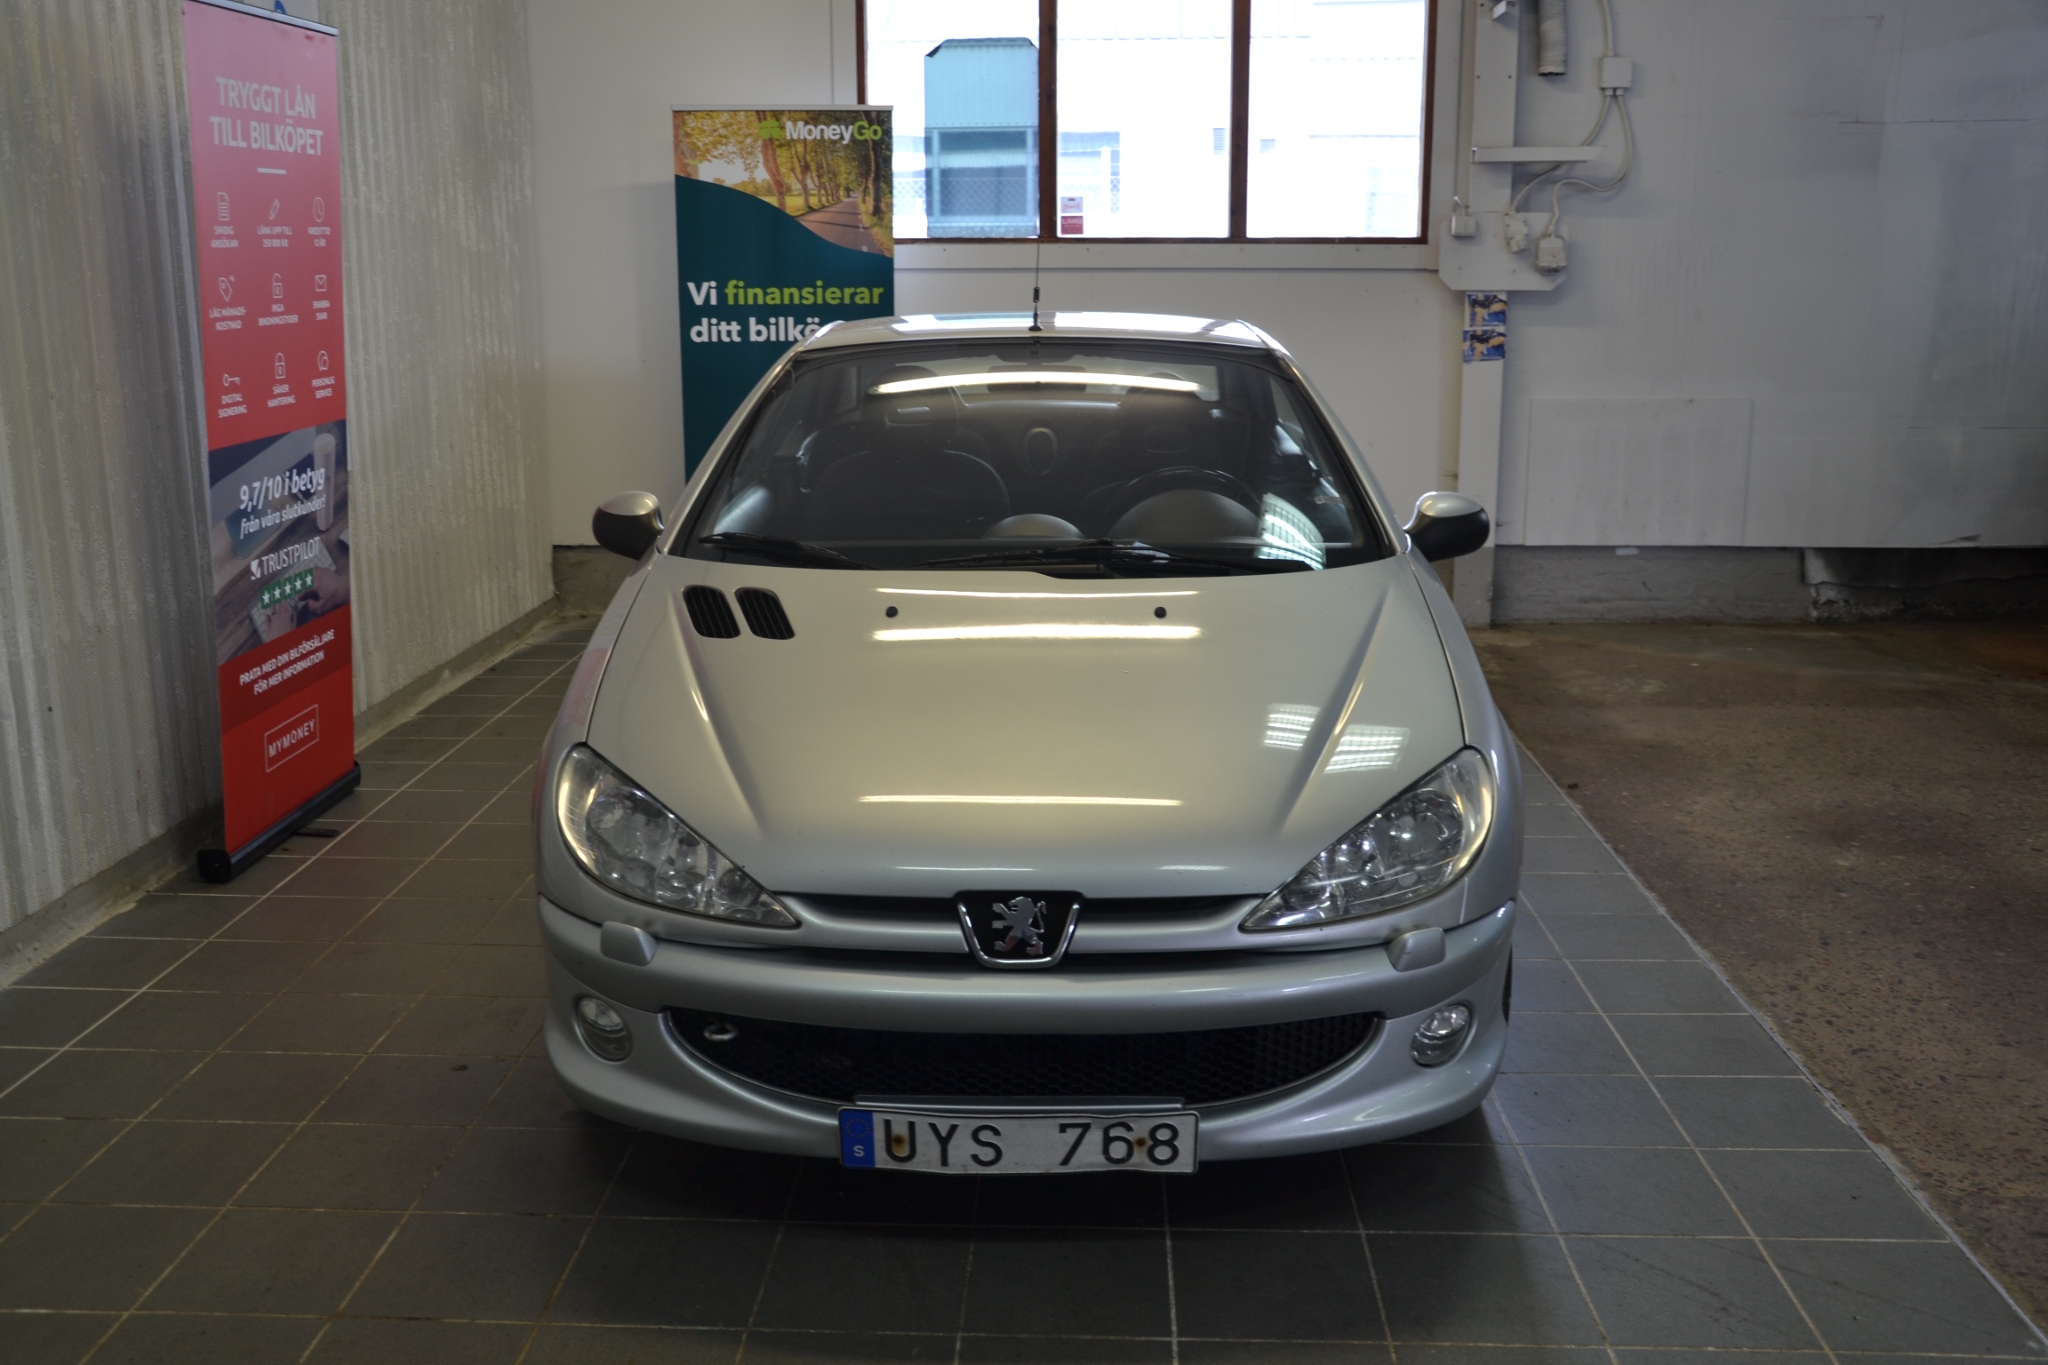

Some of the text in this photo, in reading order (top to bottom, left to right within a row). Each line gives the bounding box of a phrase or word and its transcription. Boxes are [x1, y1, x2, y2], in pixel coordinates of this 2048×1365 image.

[215, 76, 316, 119] TRYGGT LÅN
[209, 116, 323, 155] TILL BILKÖPET
[785, 121, 882, 144] MoneyGo
[687, 280, 884, 306] Vi finansierar
[689, 317, 741, 342] ditt
[221, 393, 243, 404] DIGITAL
[239, 467, 326, 513] 9,7/10 i betyg
[239, 494, 326, 540] från våra slutkunder!
[260, 536, 321, 576] TRUSTPILOT
[239, 629, 335, 686] PRATA MED DIN BILFÖRSÄLJARE
[253, 650, 325, 695] FÖR MER INFORMATION
[268, 718, 316, 758] MYMONEY
[853, 1145, 865, 1157] S
[883, 1118, 1180, 1167] UYS 768
